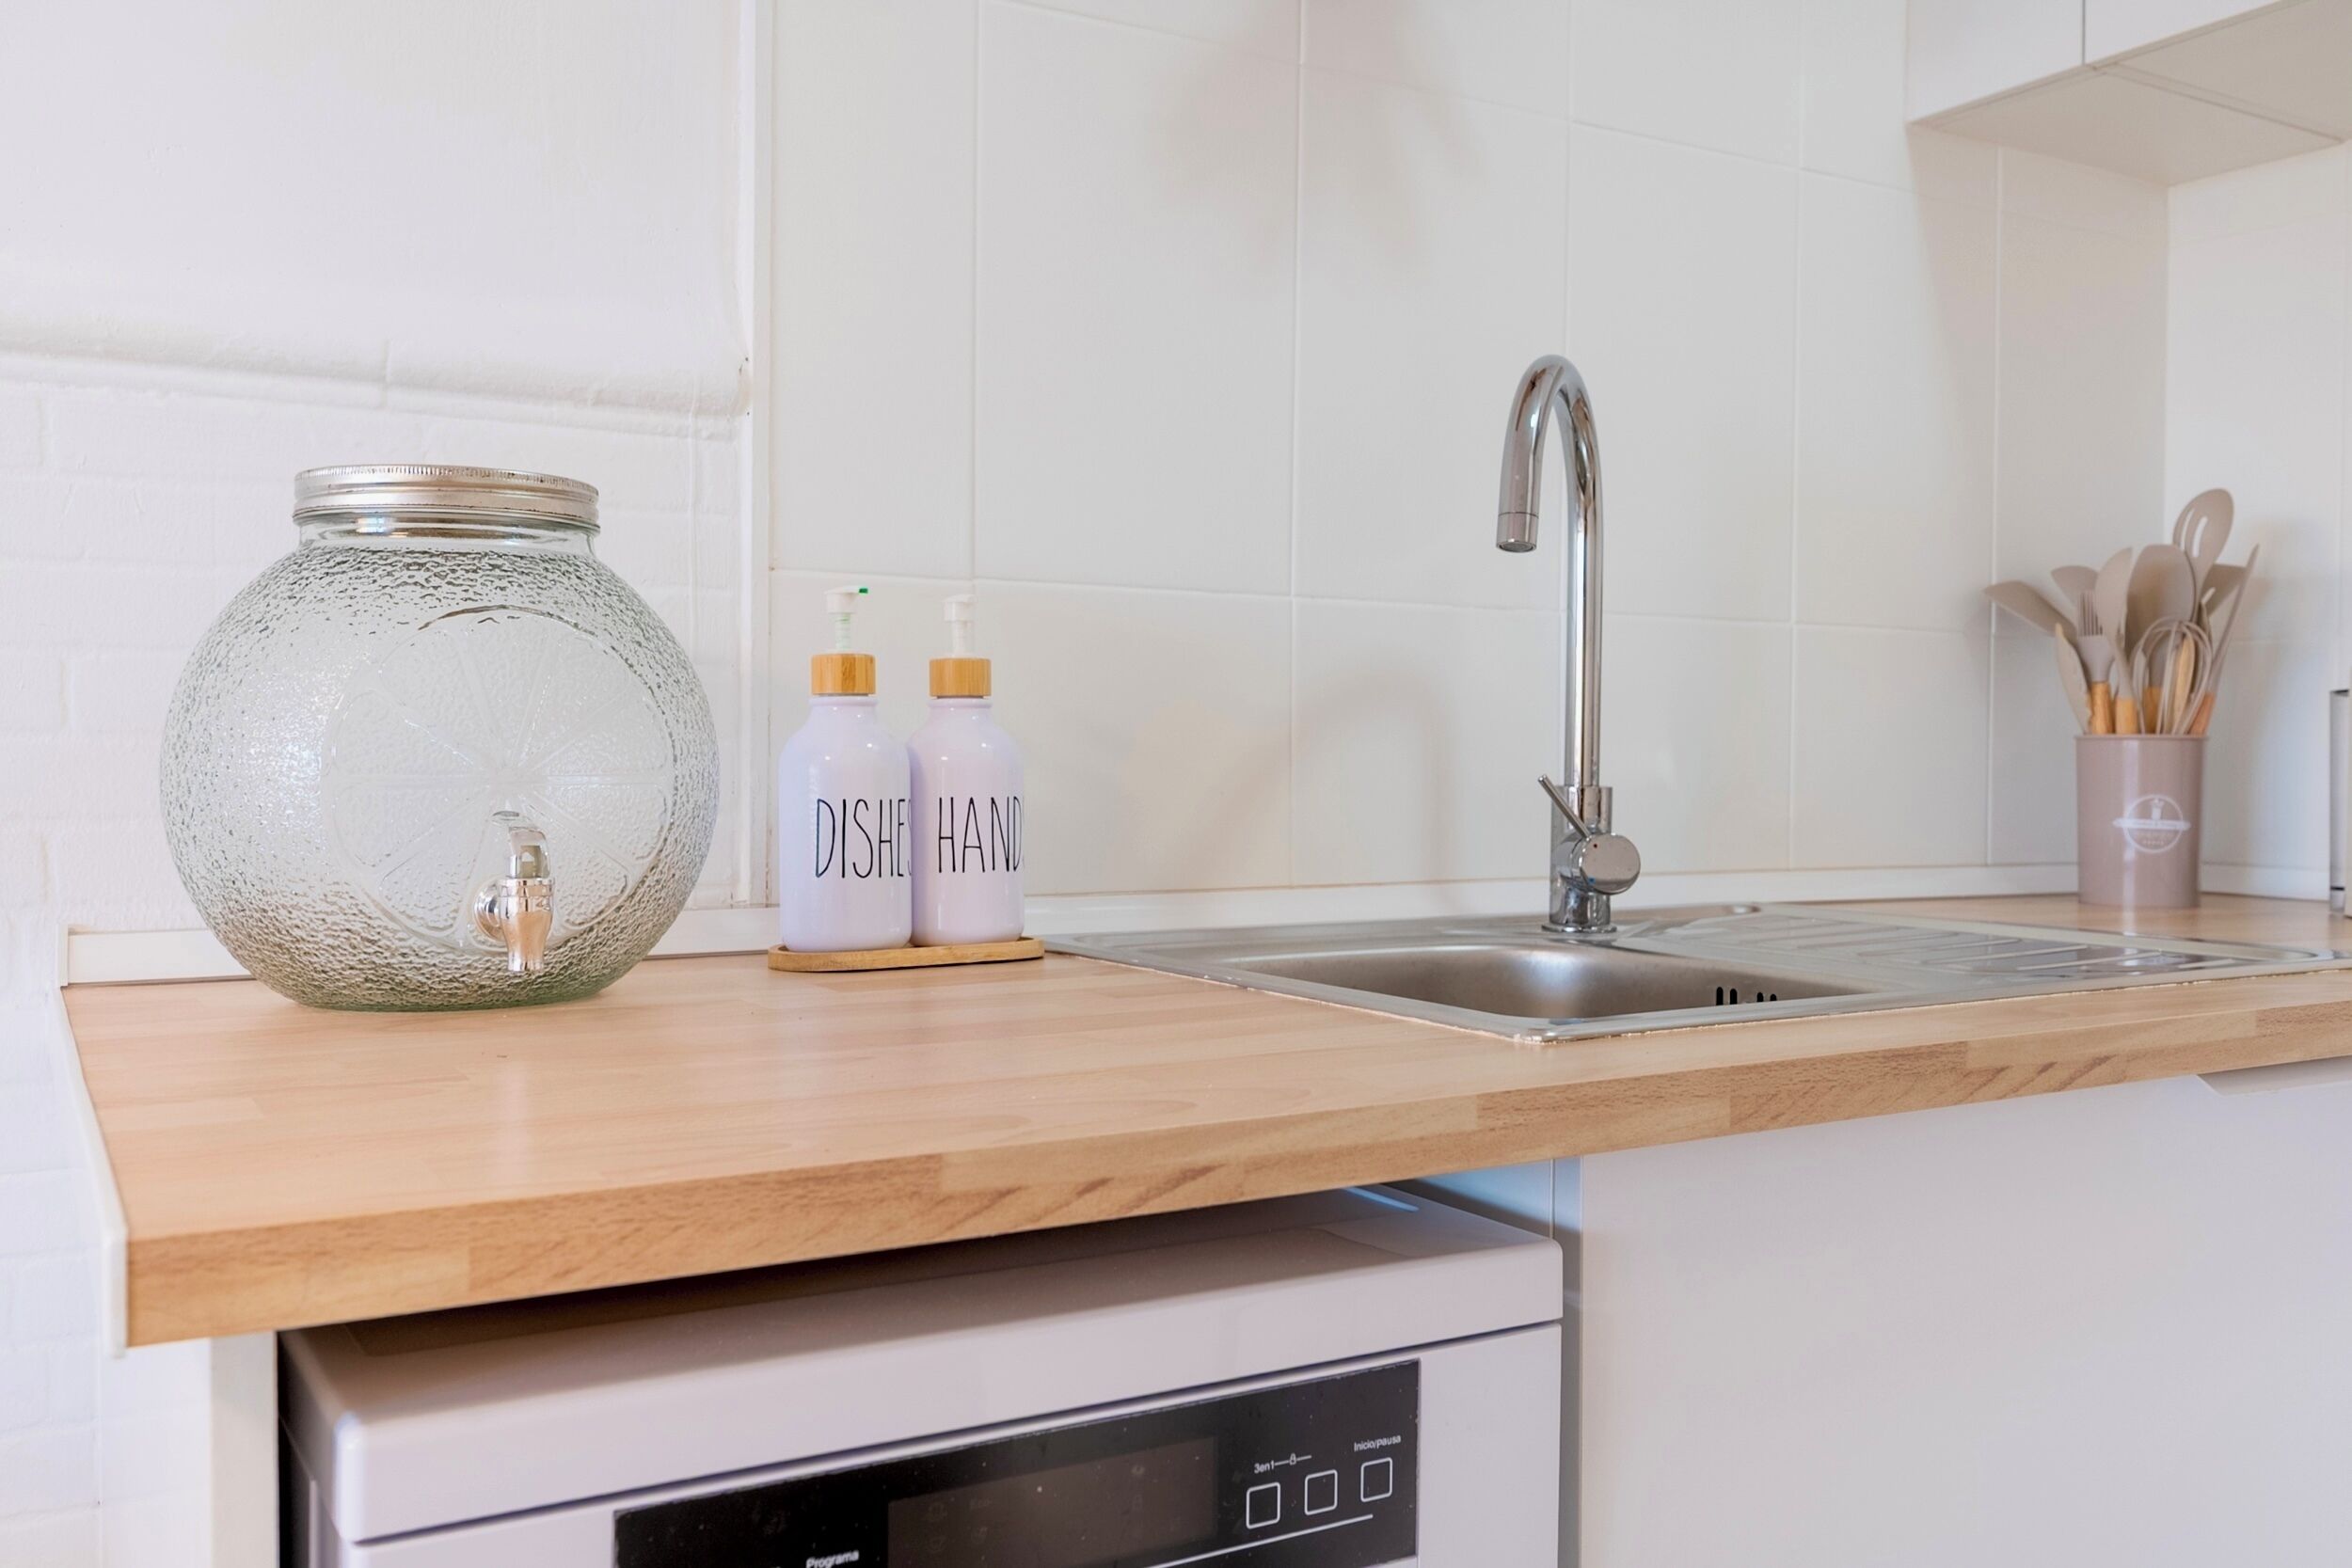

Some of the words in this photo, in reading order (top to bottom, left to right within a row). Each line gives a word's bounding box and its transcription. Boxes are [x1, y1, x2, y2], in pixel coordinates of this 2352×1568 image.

[938, 796, 1023, 874] HAND
[1353, 1434, 1402, 1452] Inicio/pausa
[805, 1550, 860, 1568] Programa
